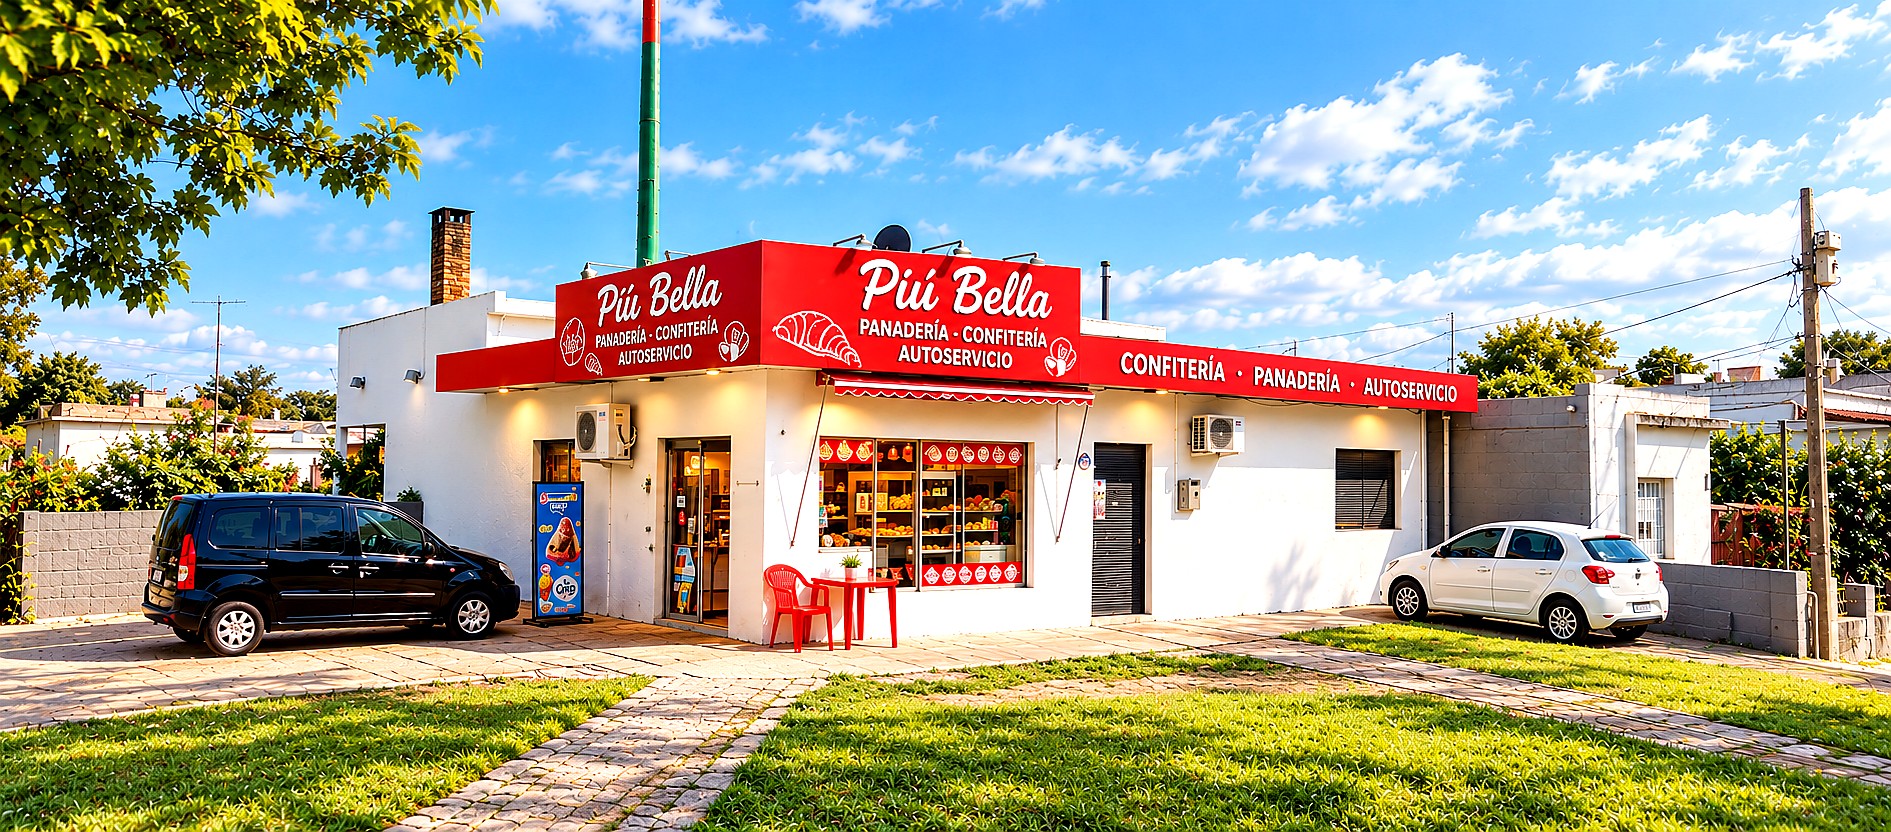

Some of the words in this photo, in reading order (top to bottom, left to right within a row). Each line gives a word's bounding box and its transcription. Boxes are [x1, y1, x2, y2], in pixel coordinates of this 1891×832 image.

[649, 264, 723, 317] Bella
[859, 258, 940, 312] Piú
[952, 265, 1053, 319] Bella
[595, 324, 647, 349] PANADERÍA
[655, 314, 719, 341] CONFITERÍA
[859, 317, 950, 342] PANADERÍA
[961, 325, 1048, 349] CONFITERÍA
[617, 343, 693, 366] AUTOSERVICIO
[897, 344, 1013, 369] AUTOSERVICIO
[1120, 351, 1226, 382] CONFITERÍA
[1254, 366, 1341, 393] PANADERÍA
[1363, 377, 1458, 403] AUTOSERVICIO
